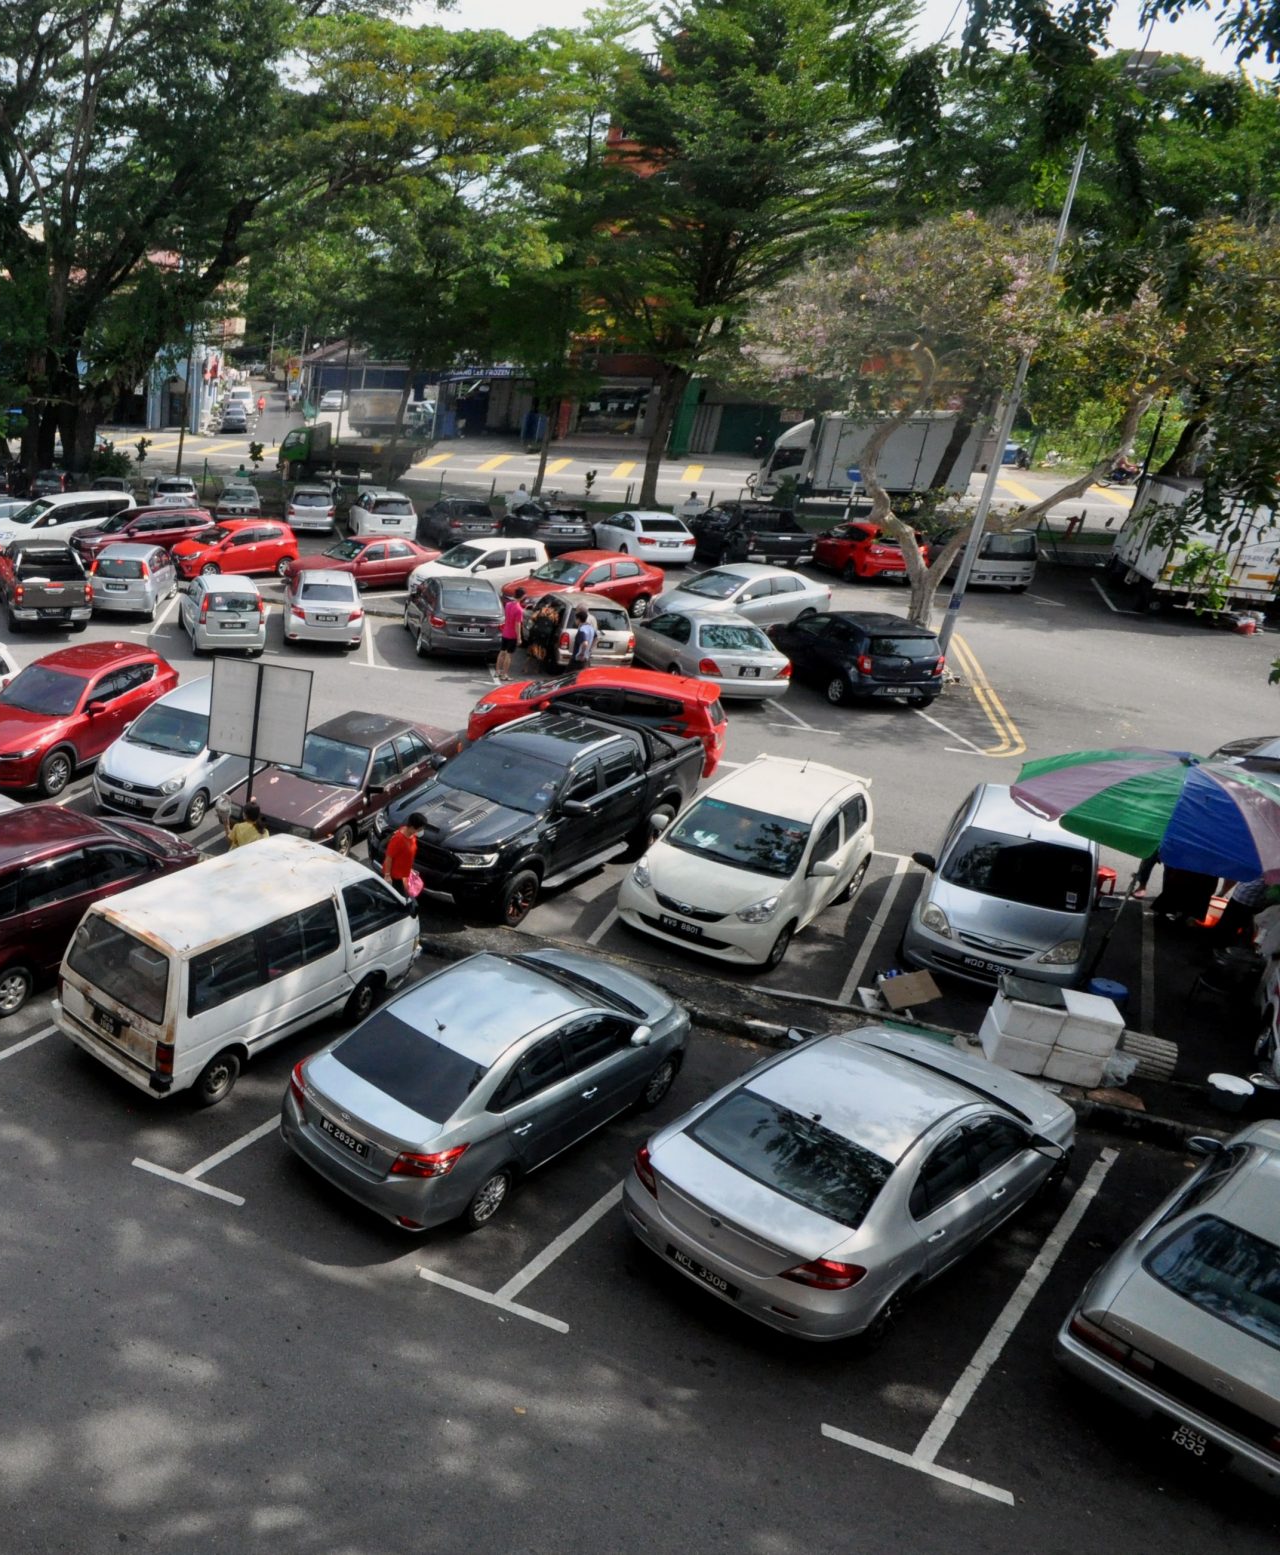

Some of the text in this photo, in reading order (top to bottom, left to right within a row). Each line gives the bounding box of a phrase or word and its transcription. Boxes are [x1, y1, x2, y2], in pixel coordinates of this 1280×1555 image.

[681, 923, 699, 935] 8801
[322, 1119, 334, 1133] WC
[356, 1144, 363, 1154] C
[674, 1250, 728, 1291] NCL 3308
[1171, 1430, 1206, 1457] 1333
